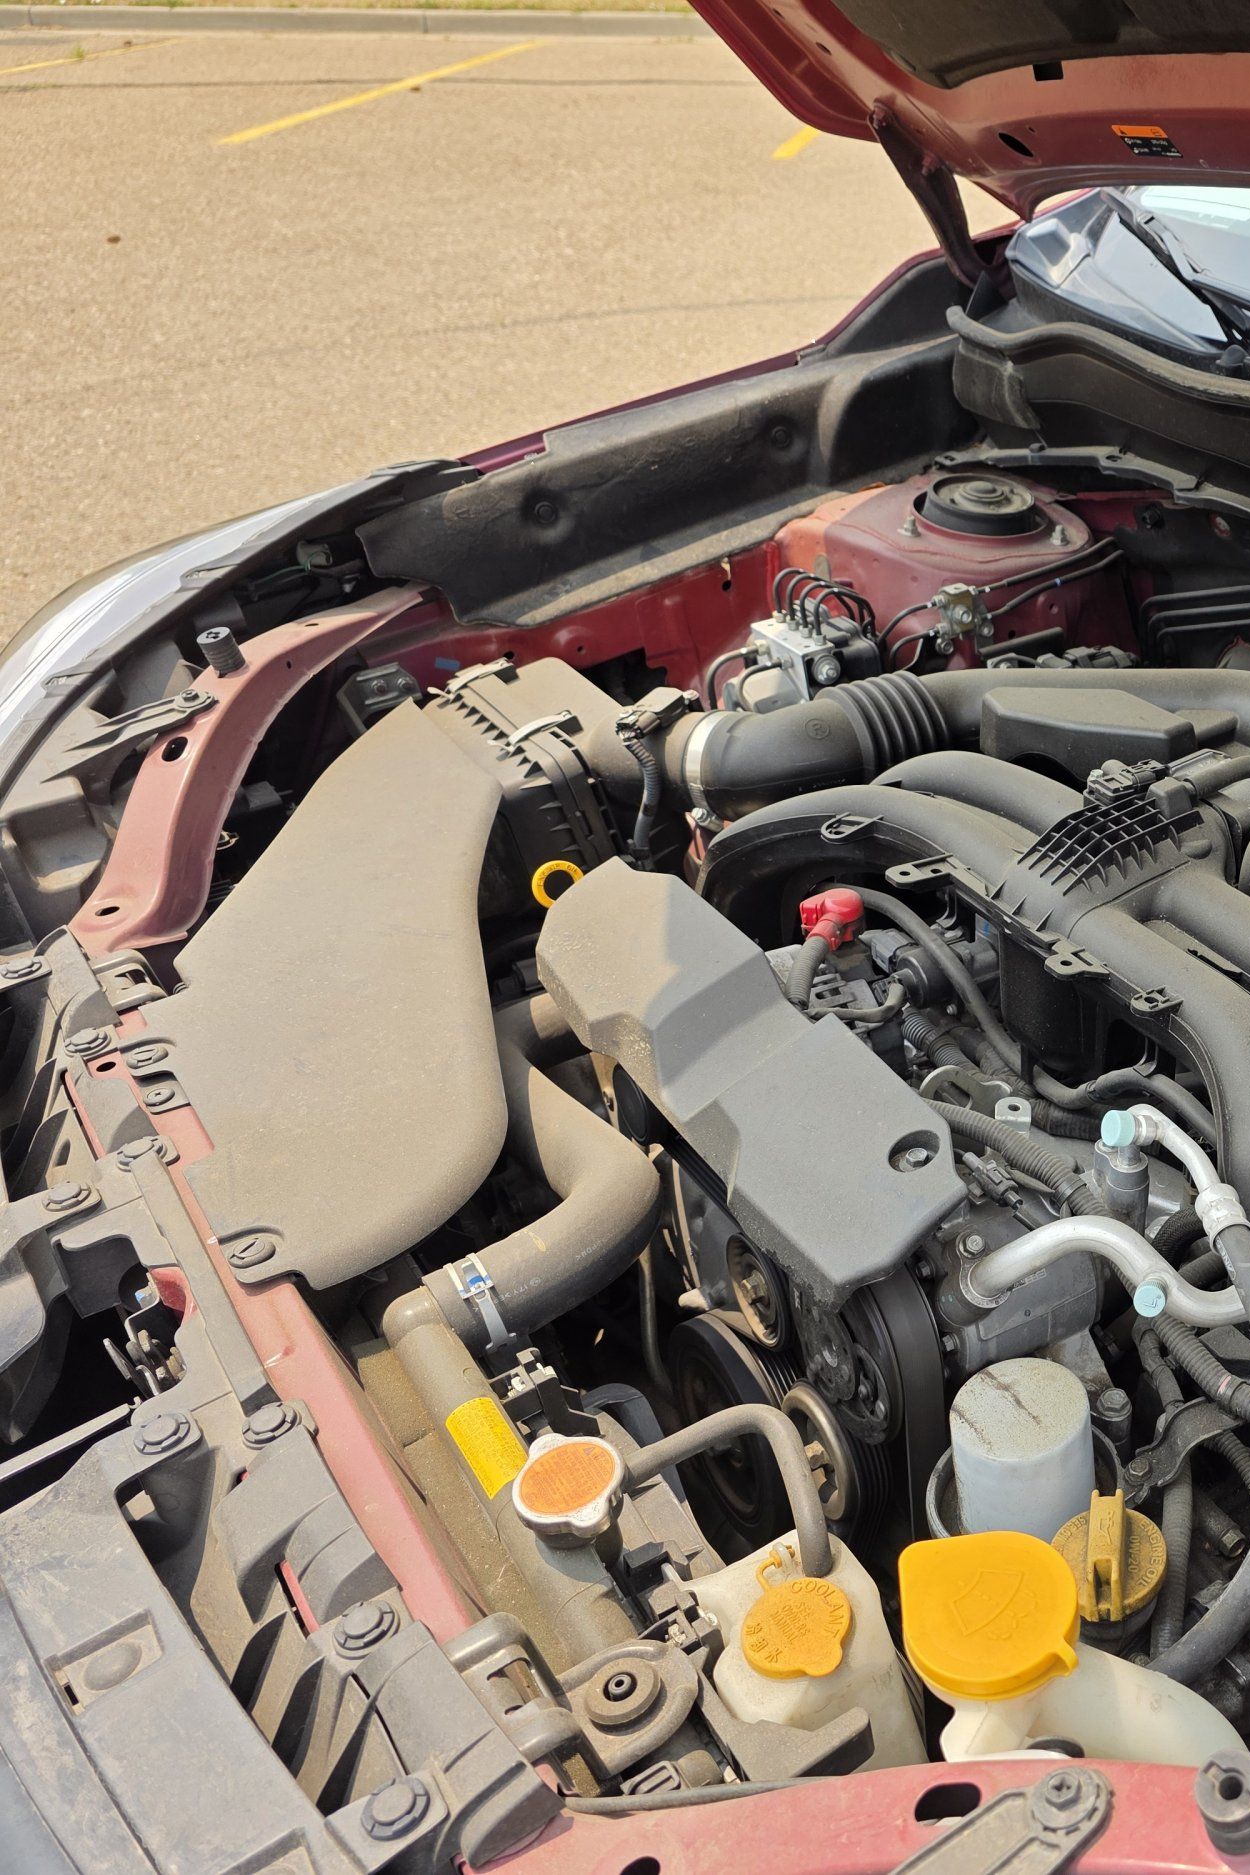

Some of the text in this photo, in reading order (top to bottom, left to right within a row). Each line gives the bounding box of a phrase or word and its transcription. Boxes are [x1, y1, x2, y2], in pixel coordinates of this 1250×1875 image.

[1128, 1535, 1140, 1572] 0W-20
[1135, 1520, 1163, 1588] ENGINE OIL
[789, 1579, 844, 1641] COOLANT
